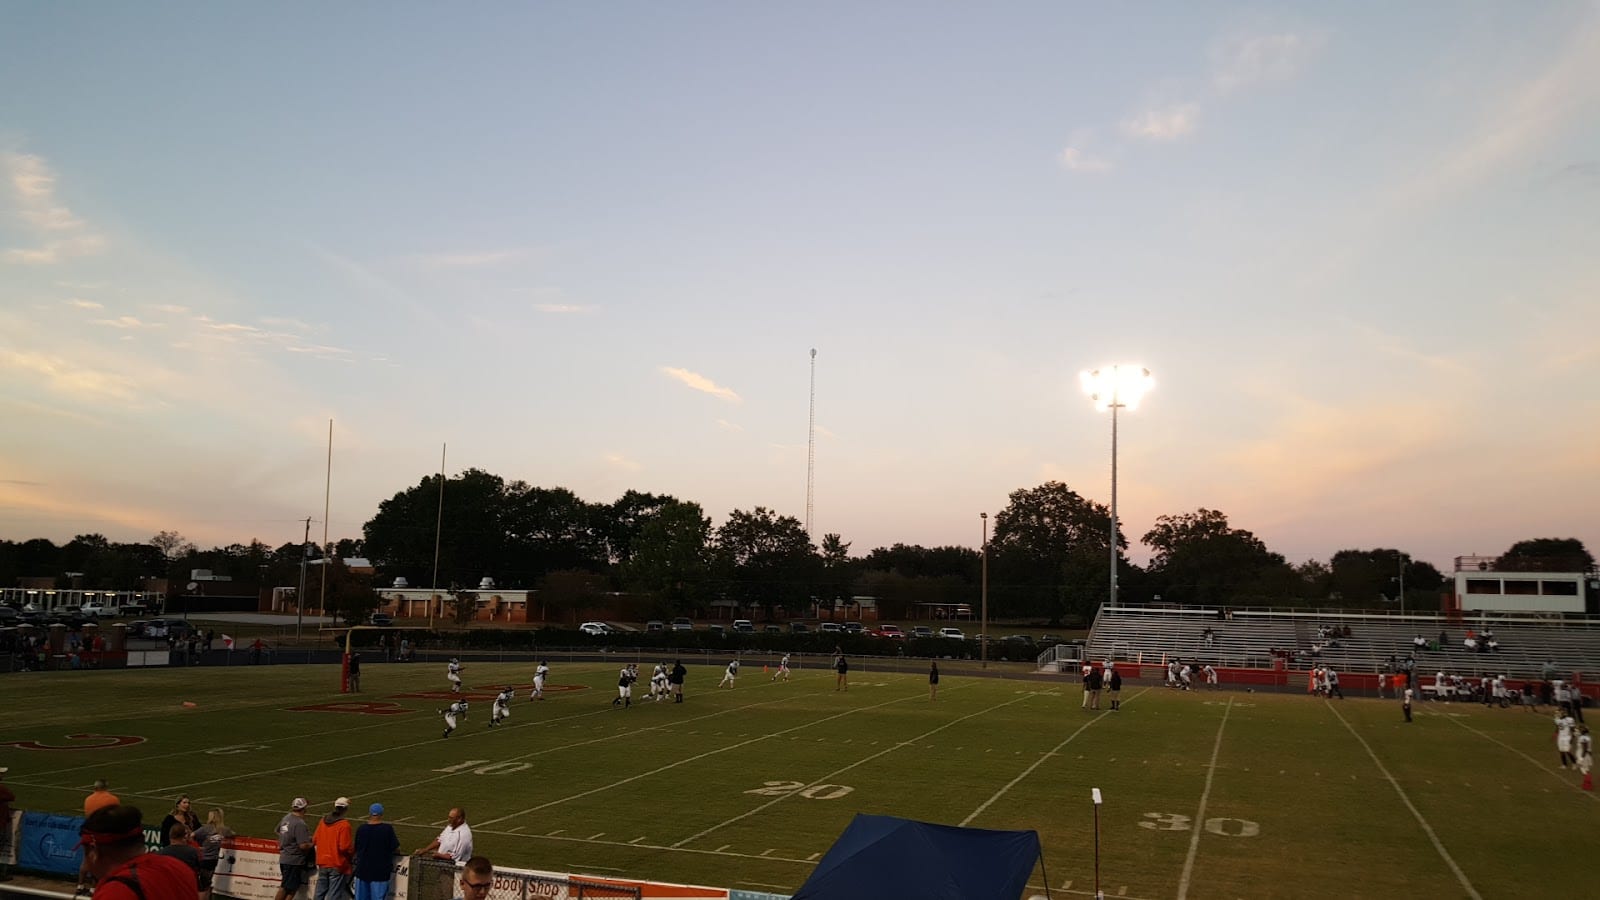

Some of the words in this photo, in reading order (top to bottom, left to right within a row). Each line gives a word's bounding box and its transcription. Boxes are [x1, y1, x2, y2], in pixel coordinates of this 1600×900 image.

[432, 759, 534, 776] 10
[742, 780, 855, 800] 20
[1137, 812, 1260, 837] 30
[494, 875, 523, 896] Body
[528, 878, 560, 898] Shop
